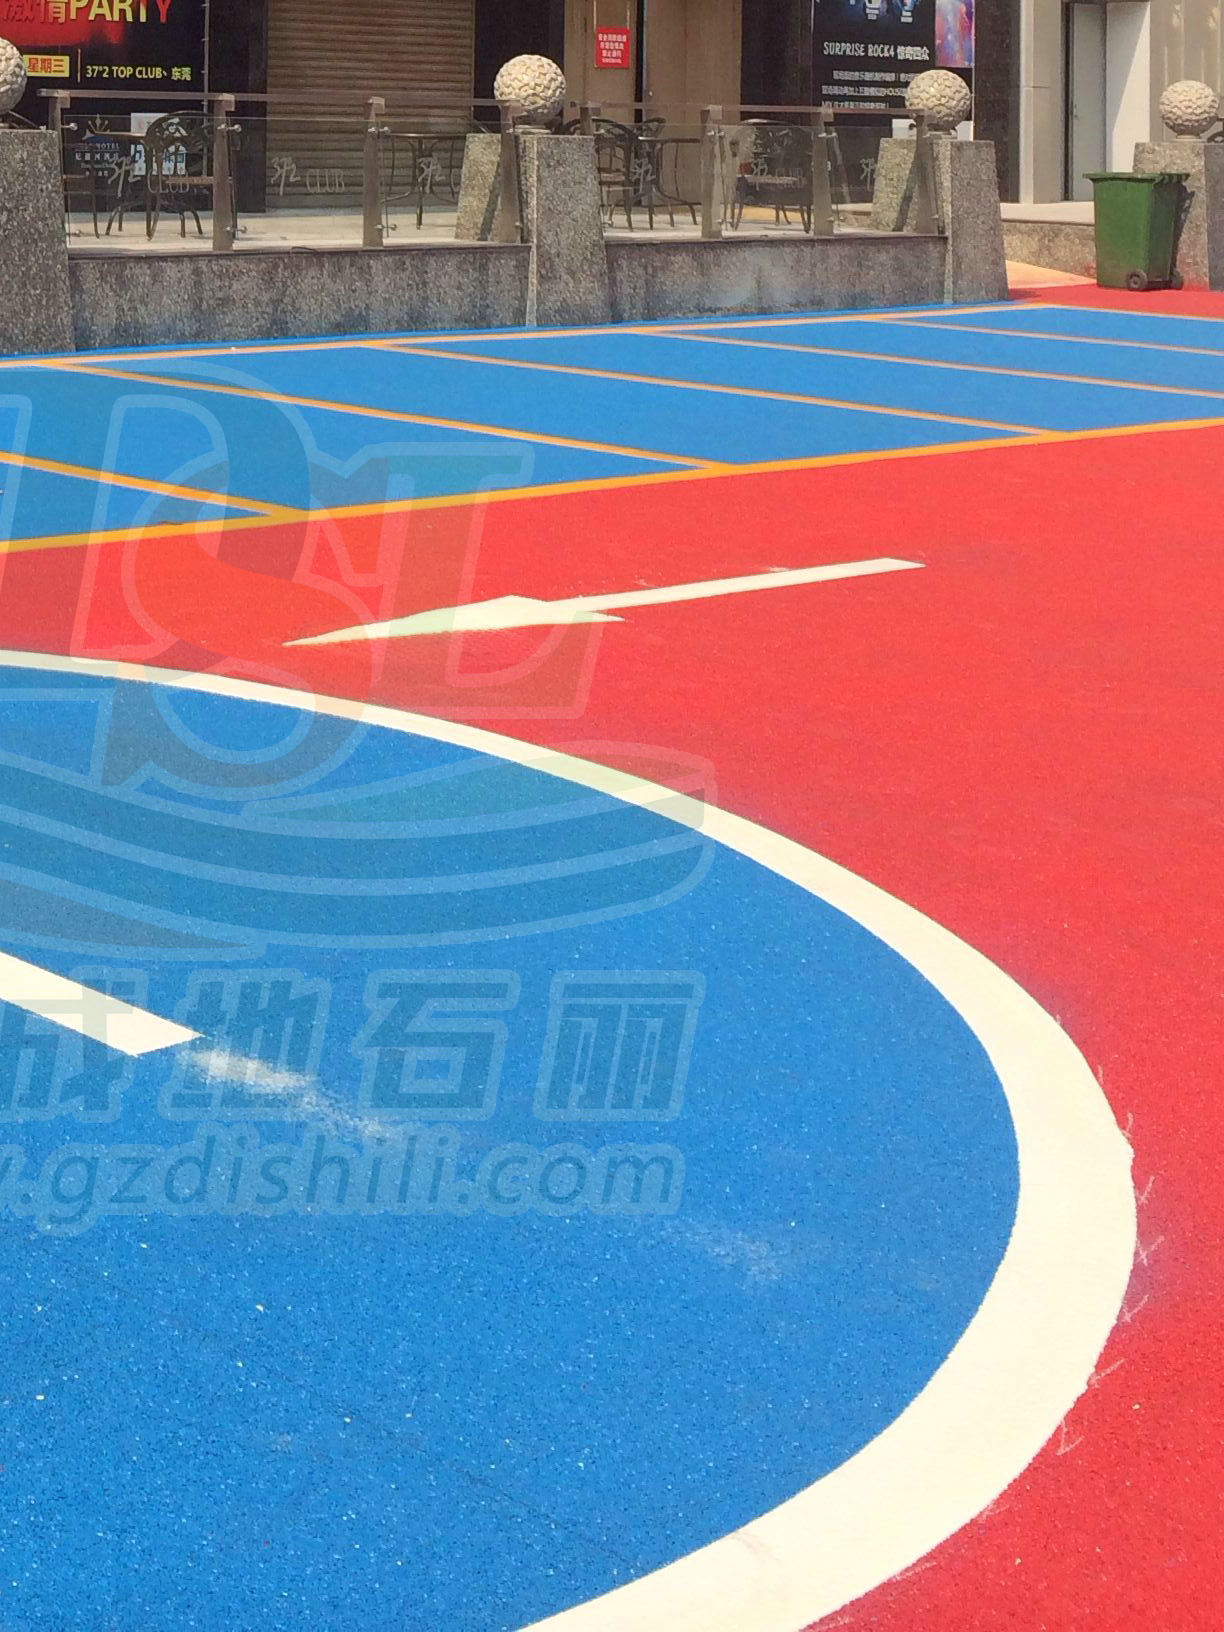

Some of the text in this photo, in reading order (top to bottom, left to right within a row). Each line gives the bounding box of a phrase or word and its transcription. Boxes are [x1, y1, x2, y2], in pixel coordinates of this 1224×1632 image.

[823, 41, 866, 57] SURPRISE
[867, 43, 895, 59] ROCK4
[27, 57, 67, 74] 星期三
[112, 66, 134, 80] TOP
[305, 168, 346, 193] CLUB
